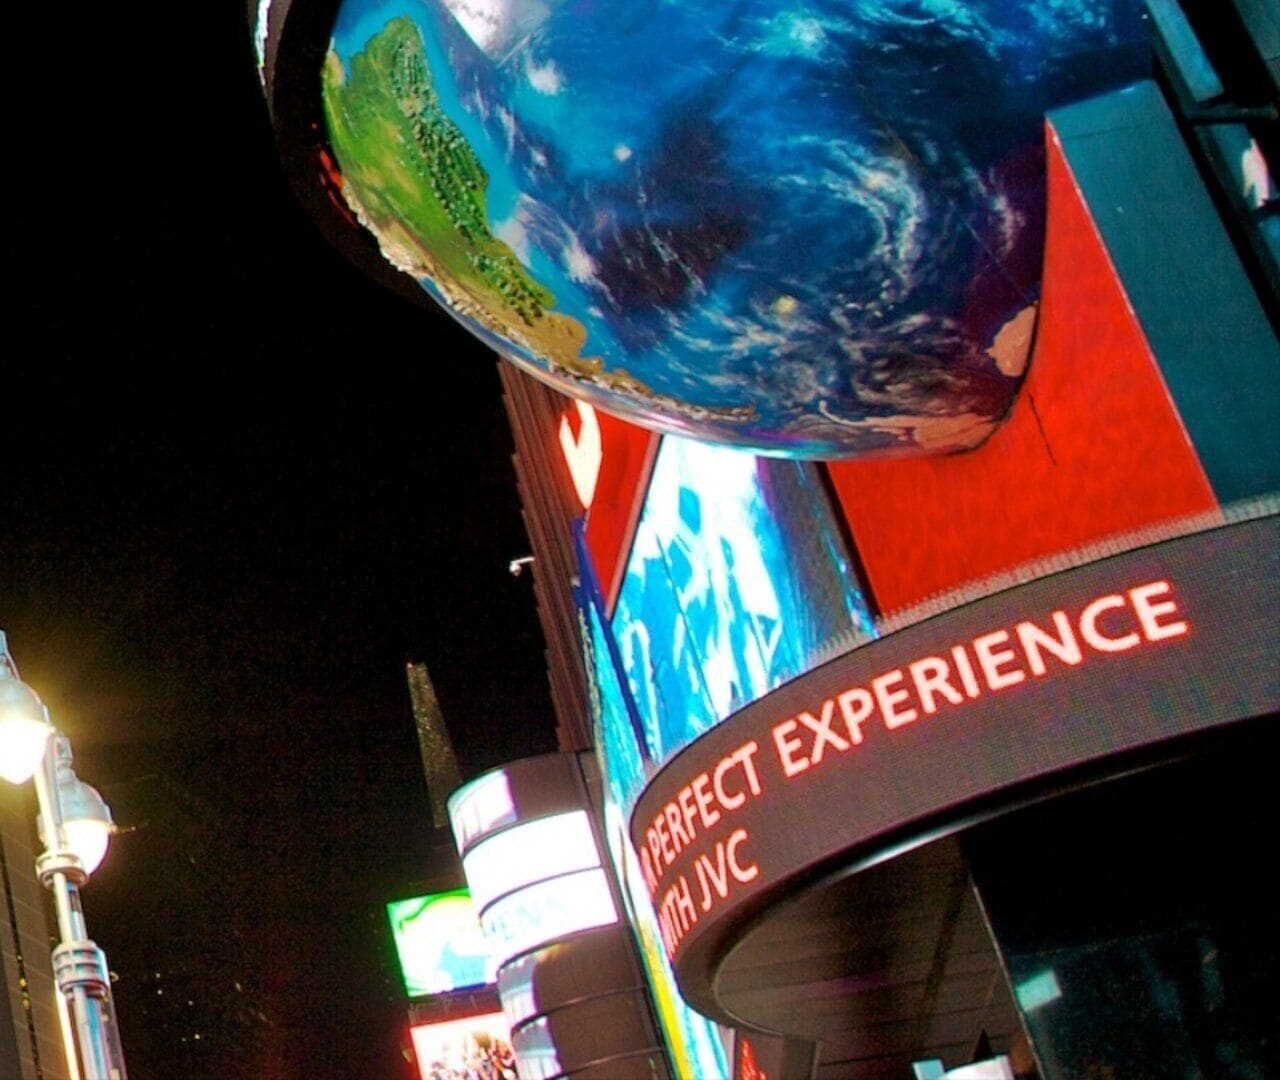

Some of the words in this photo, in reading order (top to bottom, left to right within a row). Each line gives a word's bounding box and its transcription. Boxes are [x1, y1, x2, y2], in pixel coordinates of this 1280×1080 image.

[646, 740, 762, 877] PERFECT
[771, 580, 1189, 778] EXPERIENCE
[694, 827, 760, 913] JVC
